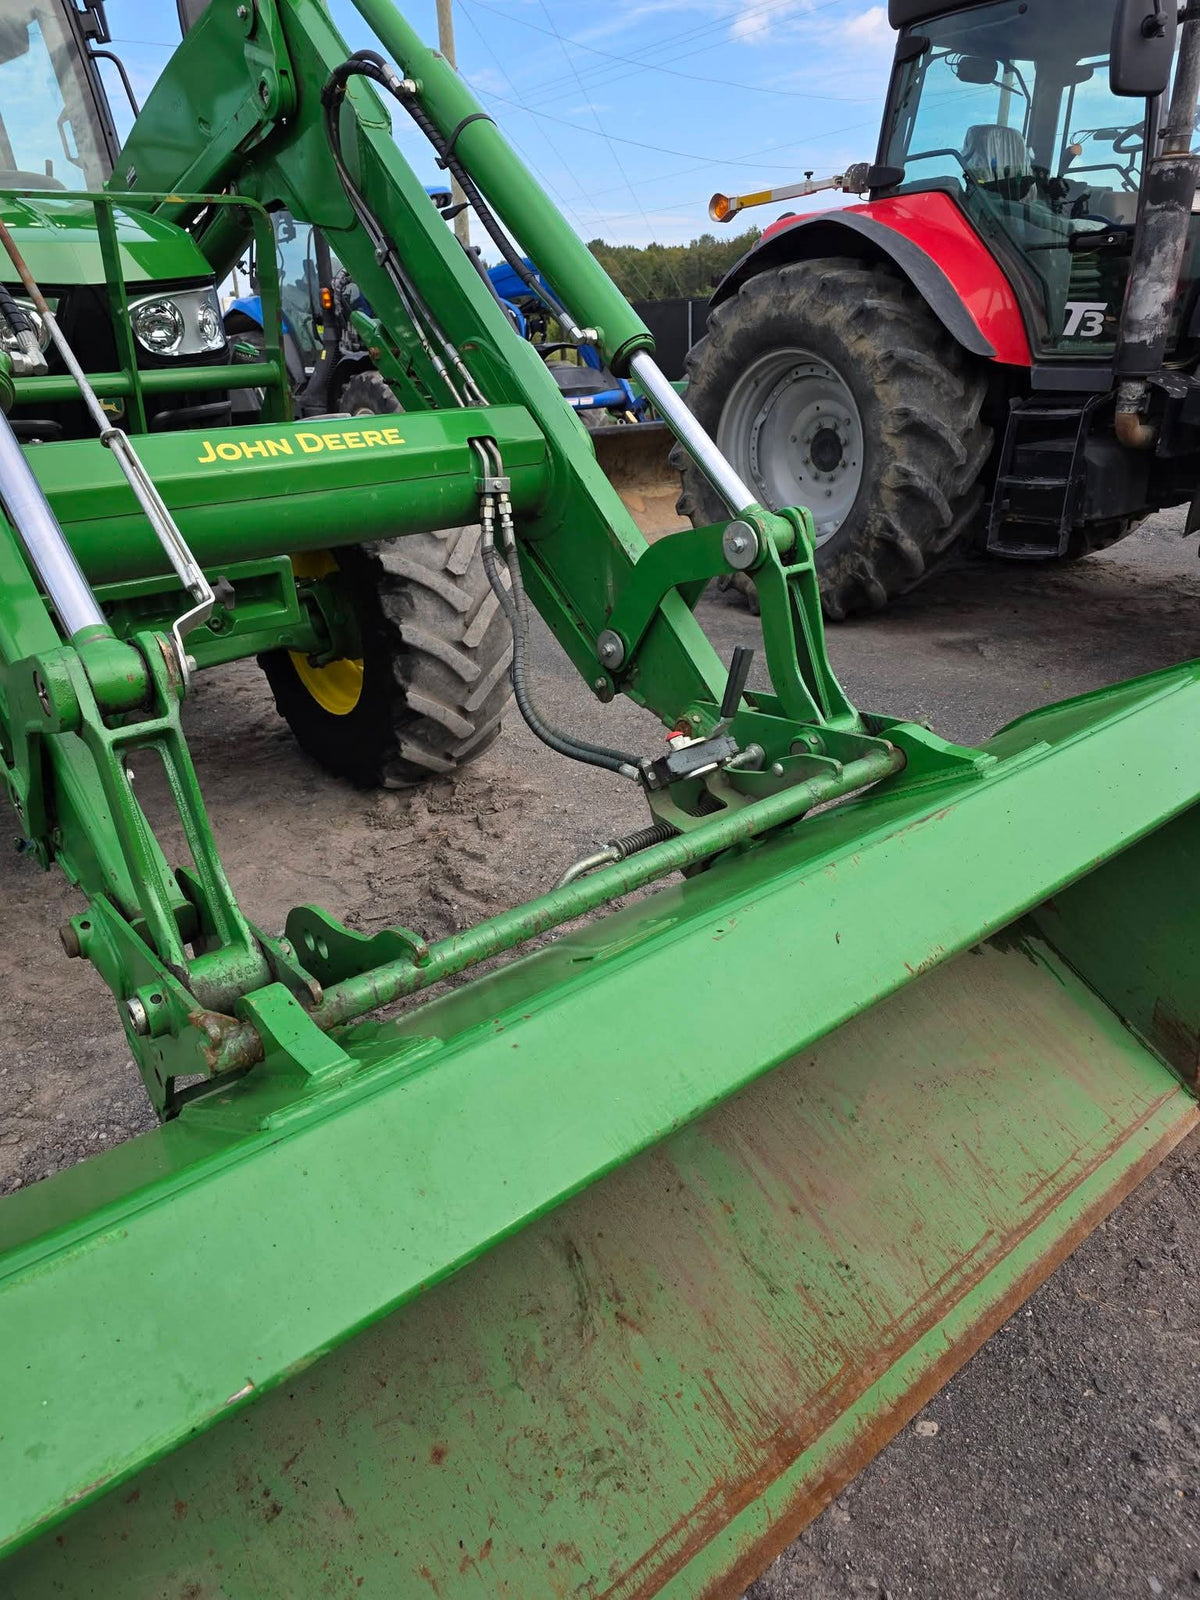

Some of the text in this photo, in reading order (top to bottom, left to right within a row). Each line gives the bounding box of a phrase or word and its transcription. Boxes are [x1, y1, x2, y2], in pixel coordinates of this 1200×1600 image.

[1062, 301, 1108, 337] T3
[198, 428, 406, 463] JOHN DEERE
